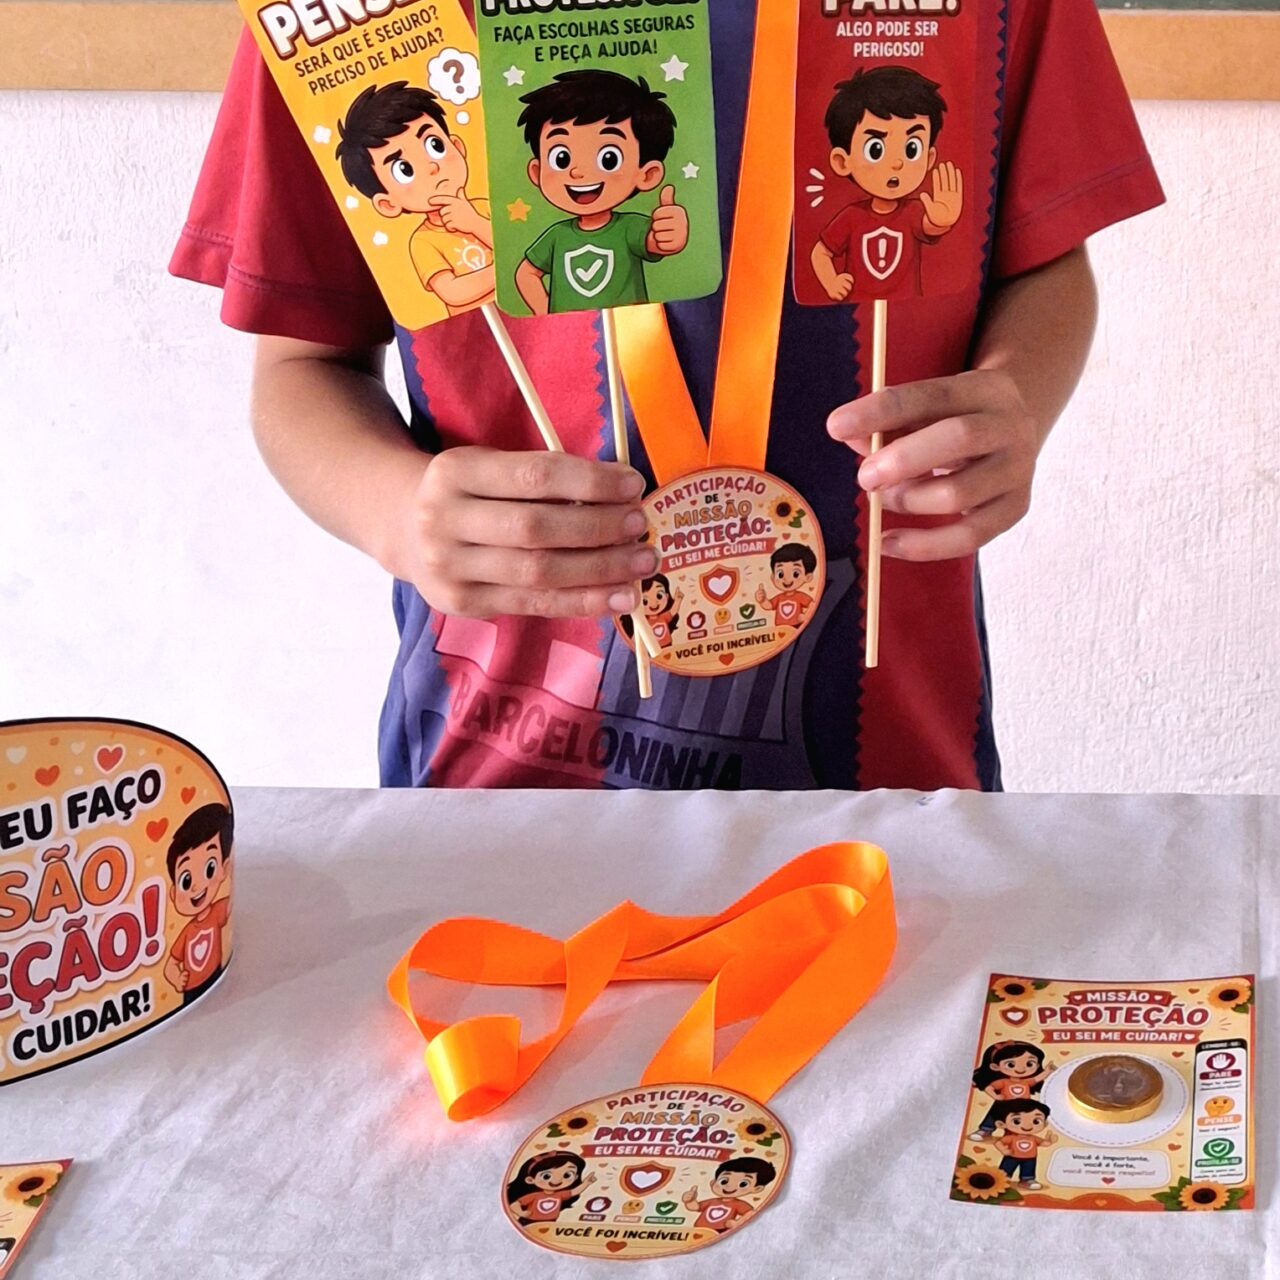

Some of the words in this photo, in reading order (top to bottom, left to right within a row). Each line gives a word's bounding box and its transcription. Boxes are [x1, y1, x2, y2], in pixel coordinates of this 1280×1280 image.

[494, 25, 534, 45] FAÇA
[539, 19, 619, 39] ESCOLHAS
[624, 14, 695, 34] SEGURAS
[836, 21, 872, 37] ALGO
[876, 21, 911, 37] PODE
[914, 21, 938, 37] SER
[295, 49, 332, 78] SERÁ
[333, 37, 363, 61] QUE
[363, 30, 374, 48] É
[376, 5, 439, 43] SEGURO?
[535, 47, 544, 62] E
[550, 44, 592, 64] PEÇA
[598, 39, 658, 58] AJUDA!
[853, 41, 925, 58] PERIGOSO!
[308, 60, 366, 96] PRECISO
[367, 51, 388, 71] DE
[392, 27, 444, 61] AJUDA?
[653, 475, 766, 514] PARTICIPAÇÃO
[704, 493, 719, 504] DE
[674, 499, 752, 529] MISSÃO
[660, 515, 772, 553] PROTEÇÃO:
[668, 556, 683, 569] EU
[685, 553, 702, 566] SEI
[704, 548, 721, 562] ME
[723, 540, 767, 556] CUIDAR!
[675, 643, 704, 660] VOCÊ
[706, 642, 724, 654] FOI
[727, 632, 776, 650] INCRÍVEL!
[0, 802, 52, 850] EU
[67, 769, 161, 830] FAÇO
[1086, 989, 1150, 1004] MISSÃO
[12, 982, 151, 1061] CUIDAR!
[1037, 1003, 1209, 1029] PROTEÇÃO
[1053, 1031, 1071, 1041] EU
[1075, 1031, 1097, 1041] SEI
[1100, 1031, 1121, 1041] ME
[1125, 1030, 1183, 1042] CUIDAR!
[1209, 1070, 1232, 1079] PARE
[606, 1089, 747, 1113] PARTICIPAÇÃO
[667, 1102, 684, 1111] DE
[620, 1109, 720, 1126] MISSÃO
[593, 1124, 737, 1146] PROTEÇÃO:
[594, 1146, 614, 1156] EU
[617, 1145, 638, 1155] SEI
[641, 1146, 662, 1156] ME
[664, 1145, 721, 1158] CUIDAR!
[555, 1226, 592, 1238] VOCÊ
[595, 1228, 621, 1239] FOI
[622, 1228, 690, 1242] INCRÍVEL!
